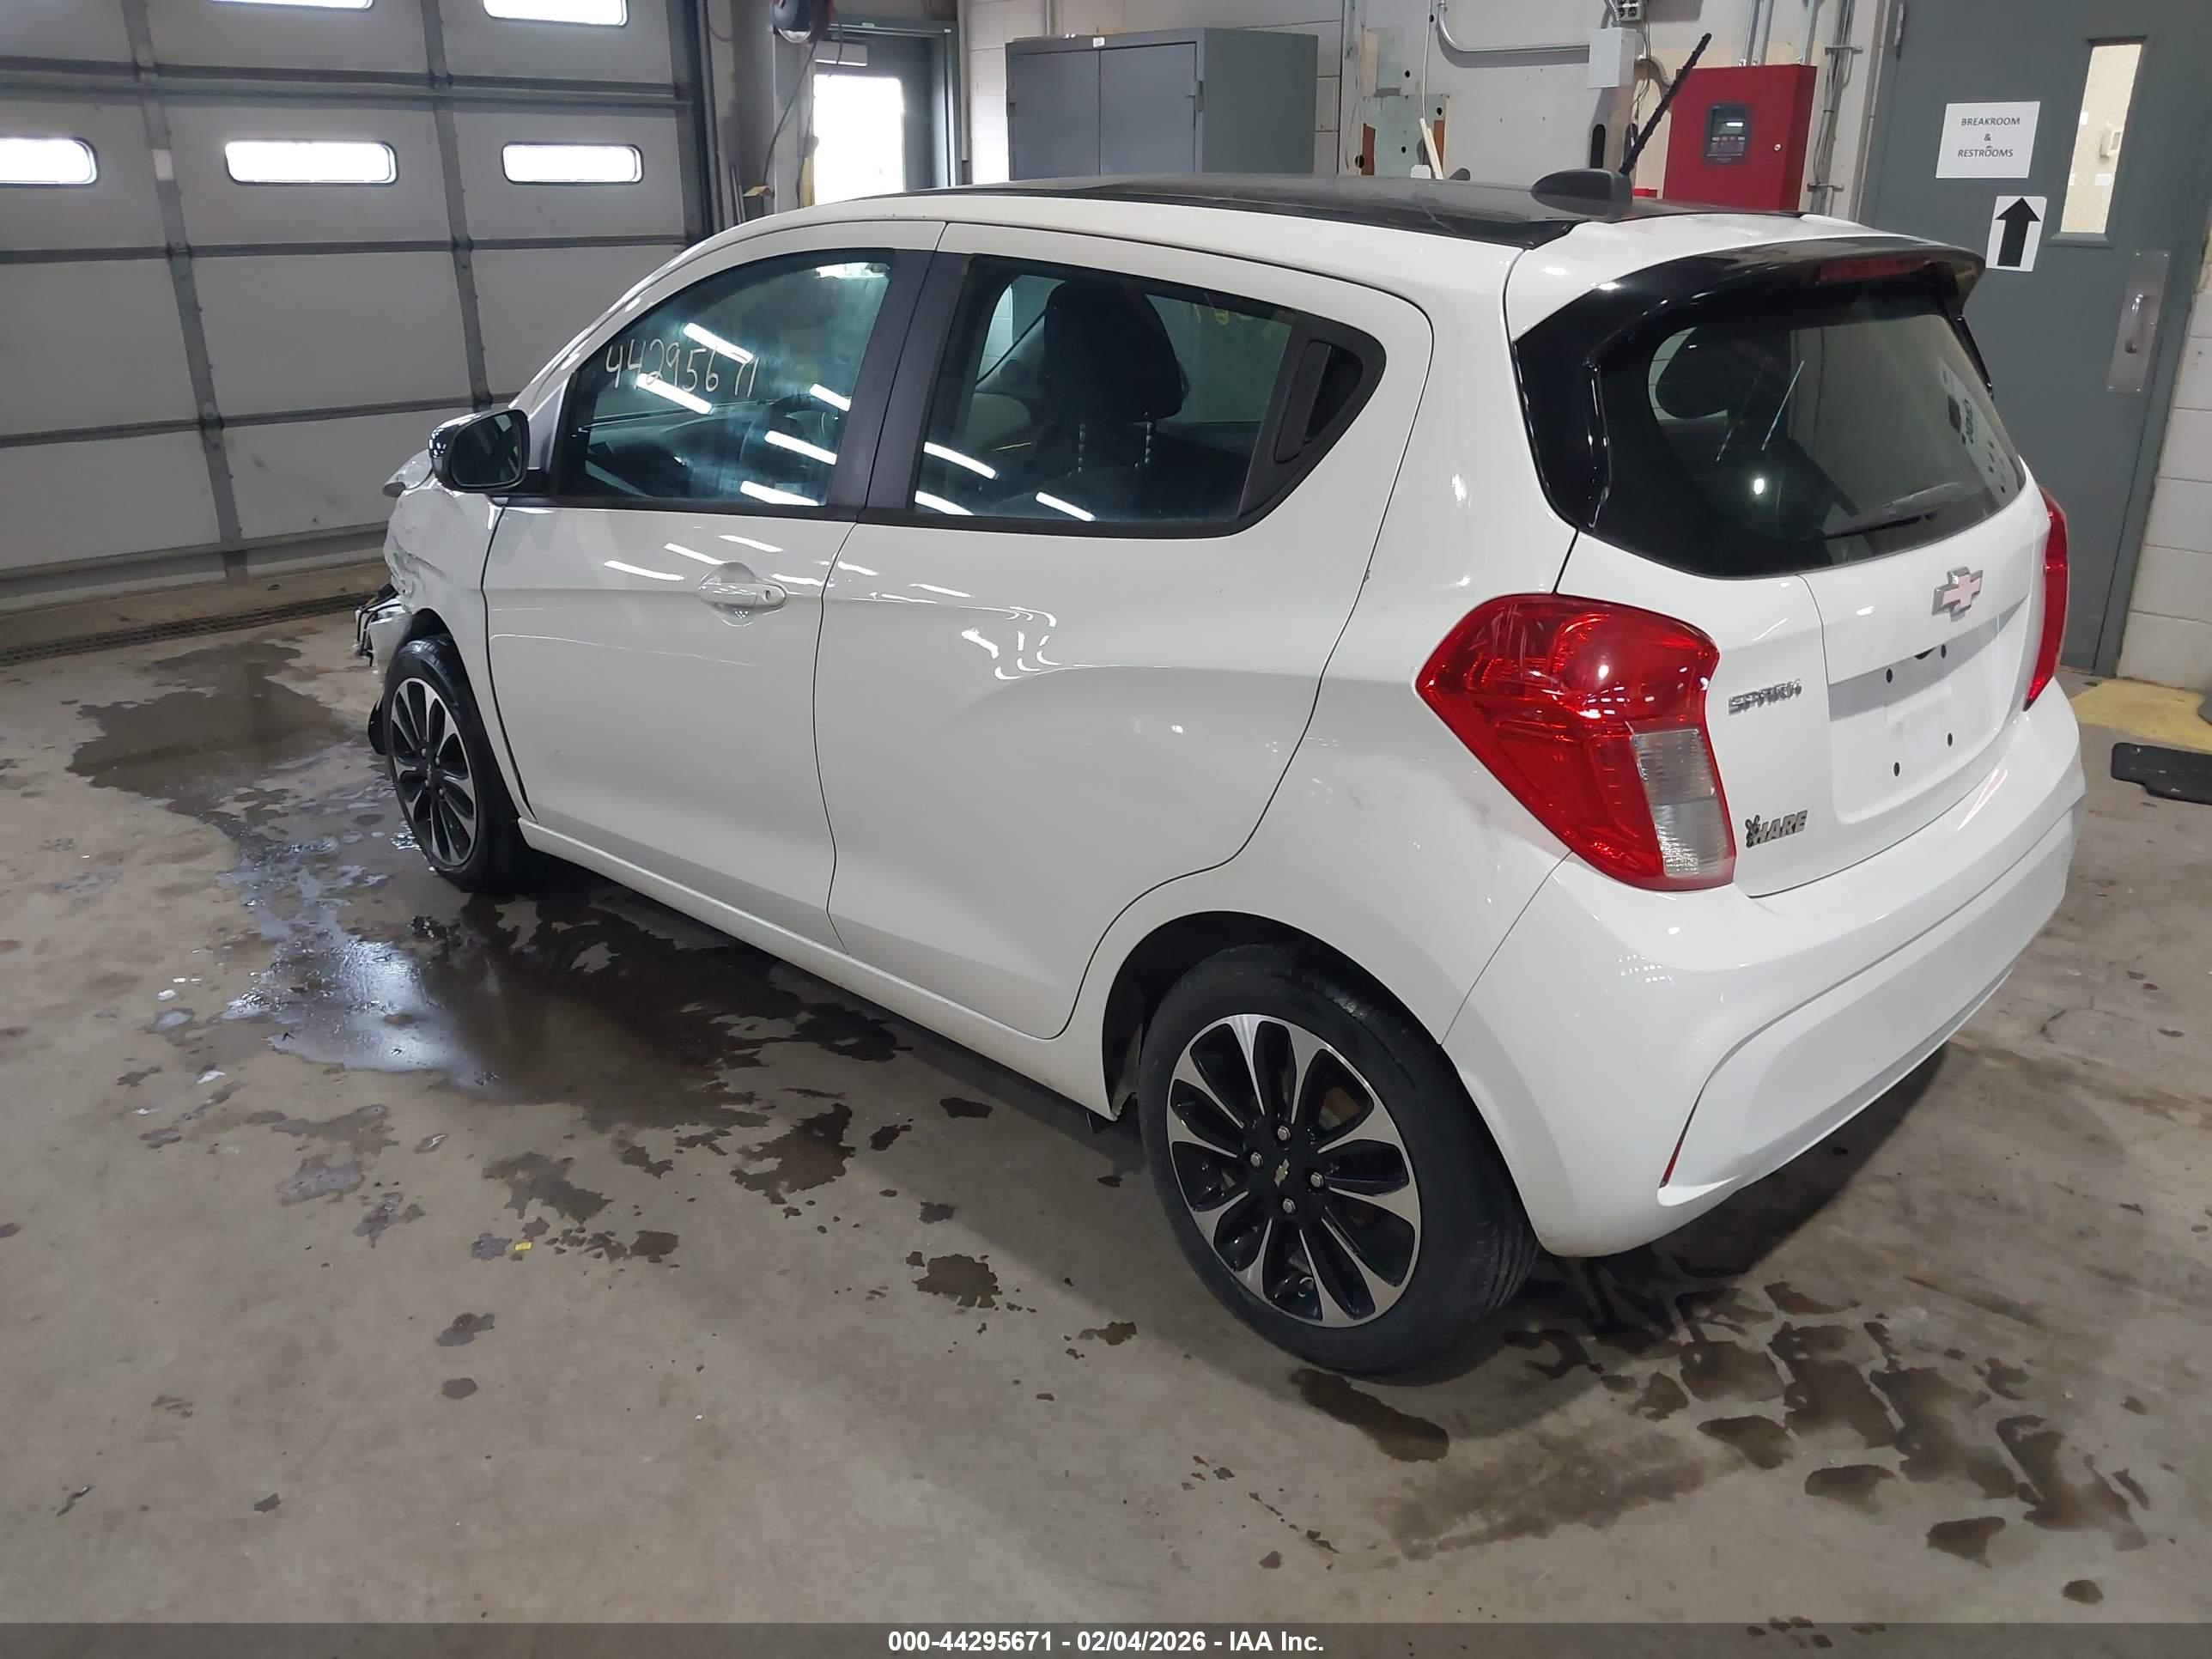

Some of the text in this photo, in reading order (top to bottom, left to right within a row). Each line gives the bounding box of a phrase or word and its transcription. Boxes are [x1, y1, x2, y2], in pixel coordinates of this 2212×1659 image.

[1960, 117, 2021, 126] BREAKROOM
[1983, 133, 1992, 142] &
[1958, 149, 2014, 158] RESTROOMS
[605, 338, 760, 398] 44295671
[1729, 679, 1802, 715] SPARK
[1746, 810, 1808, 848] HARE
